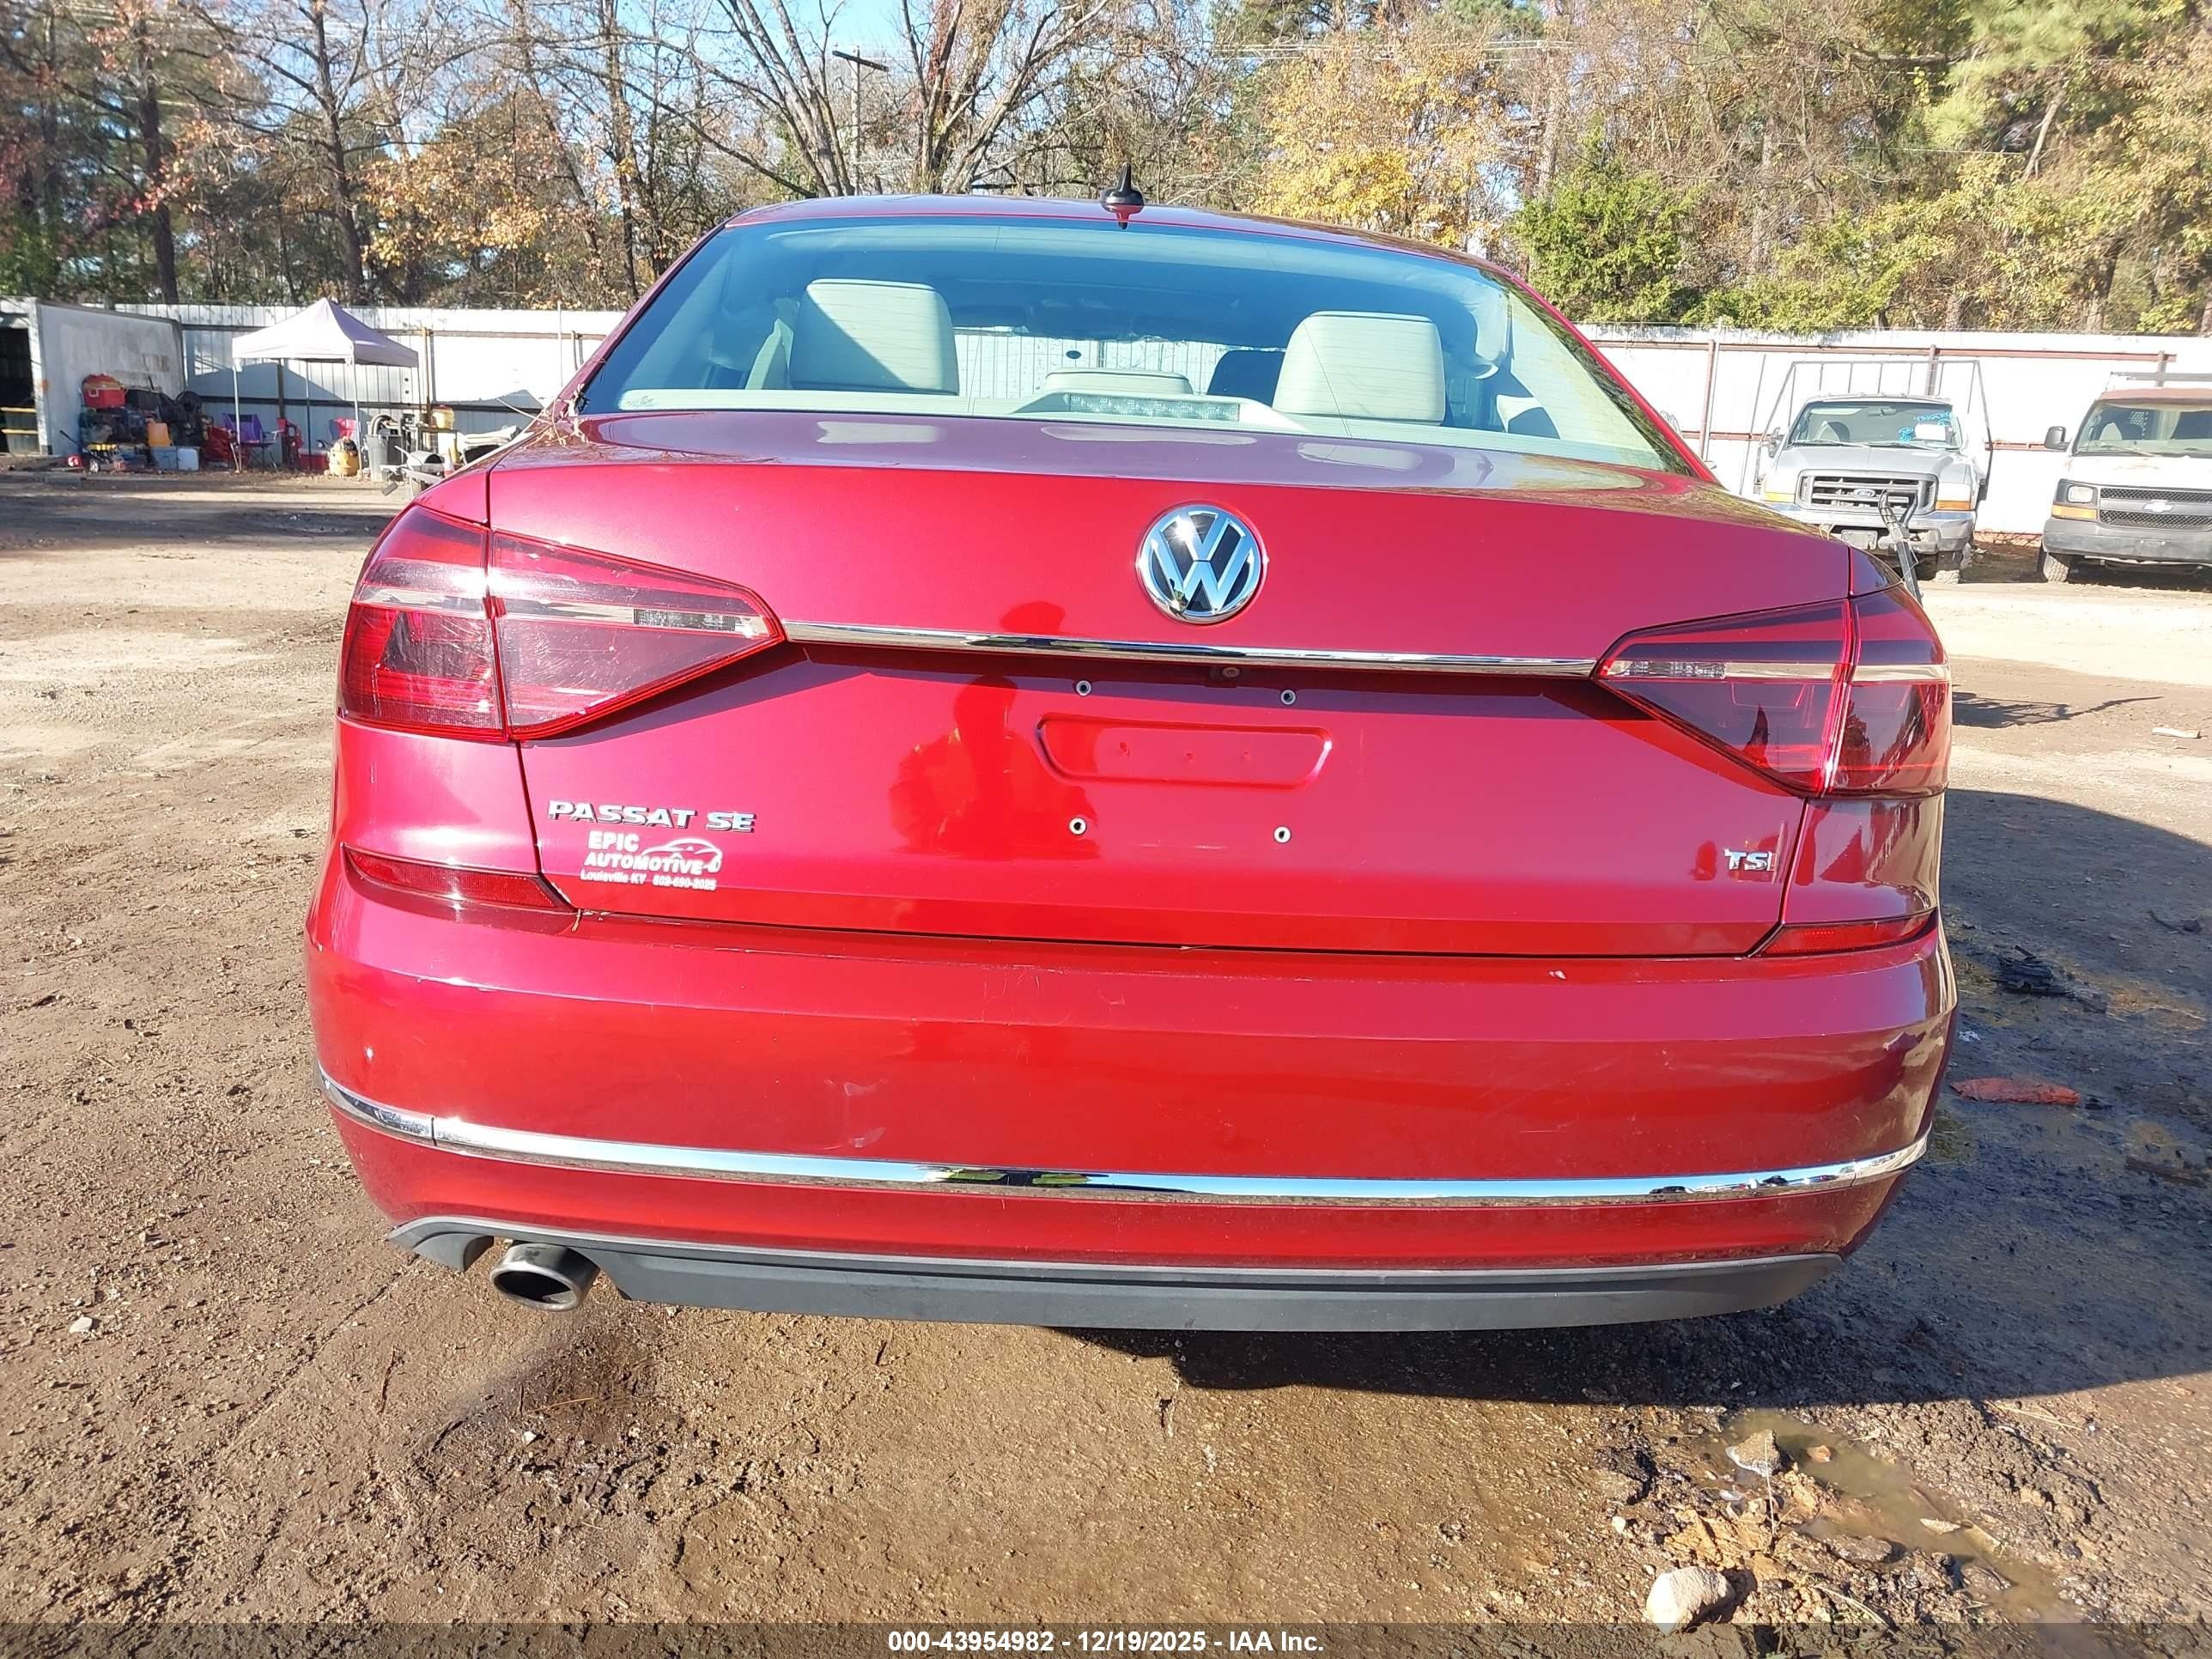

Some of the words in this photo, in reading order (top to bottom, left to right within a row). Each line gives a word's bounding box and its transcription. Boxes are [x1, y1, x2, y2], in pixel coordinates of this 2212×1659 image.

[1139, 503, 1262, 622] VW
[548, 799, 696, 828] PASSAT
[706, 811, 756, 833] SE
[587, 830, 640, 853] EPIC
[584, 852, 704, 875] AUTOMOTIVE
[1723, 848, 1777, 871] TSI
[630, 872, 647, 884] KY
